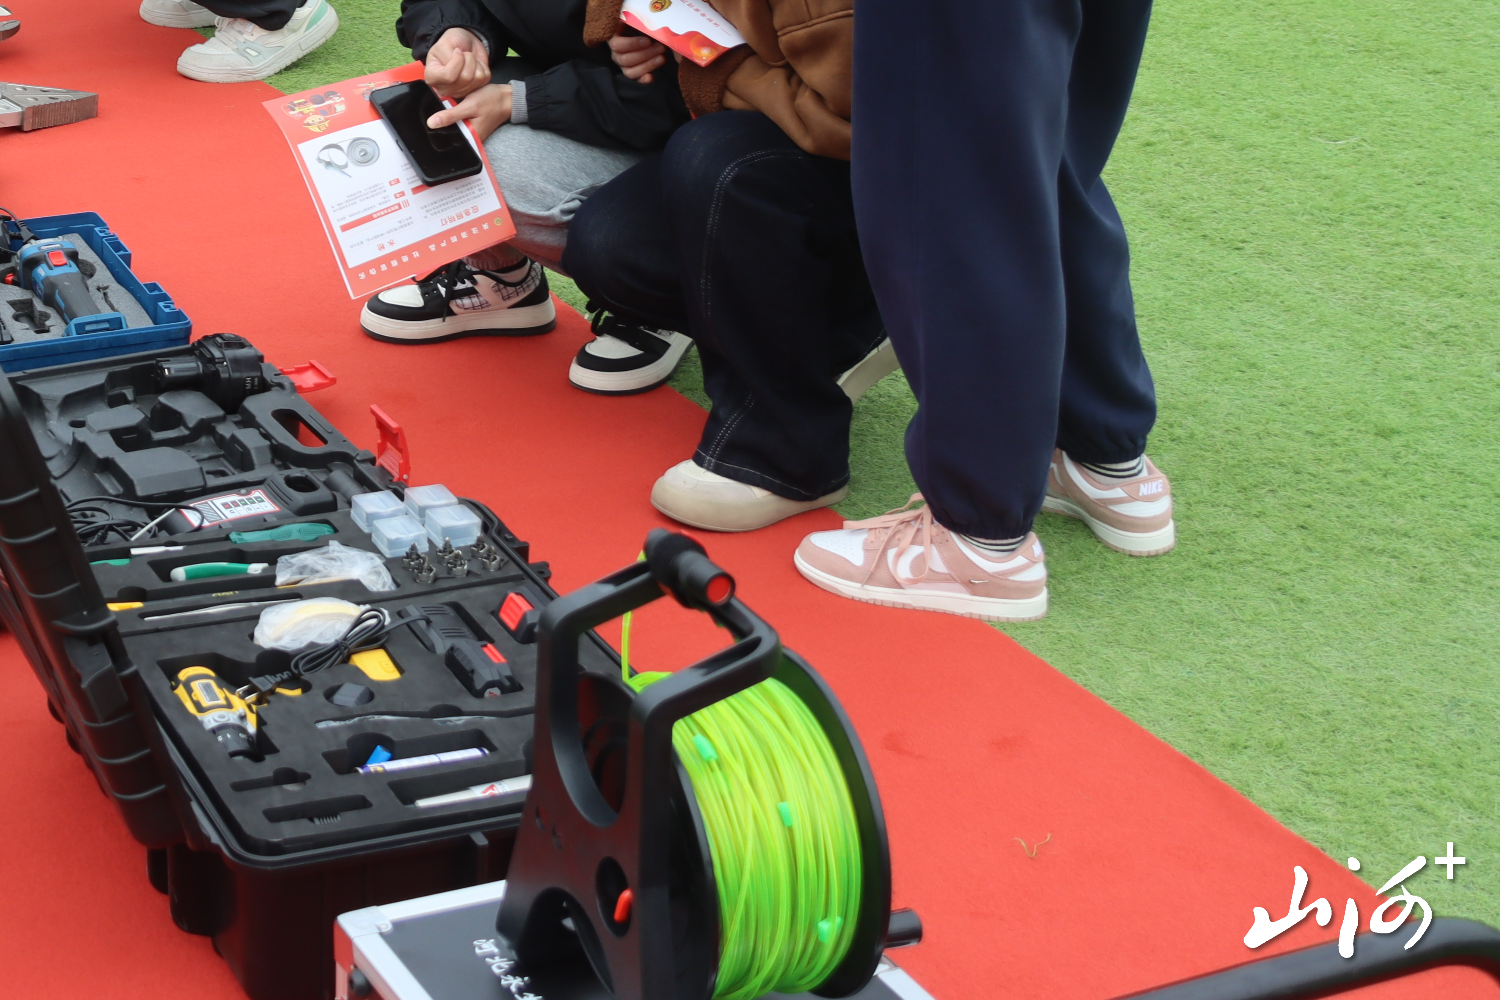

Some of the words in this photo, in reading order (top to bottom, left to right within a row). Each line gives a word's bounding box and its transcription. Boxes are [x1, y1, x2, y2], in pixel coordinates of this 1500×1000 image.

[440, 205, 479, 227] 应急照明灯
[358, 250, 420, 280] 杜绝假冒伪劣
